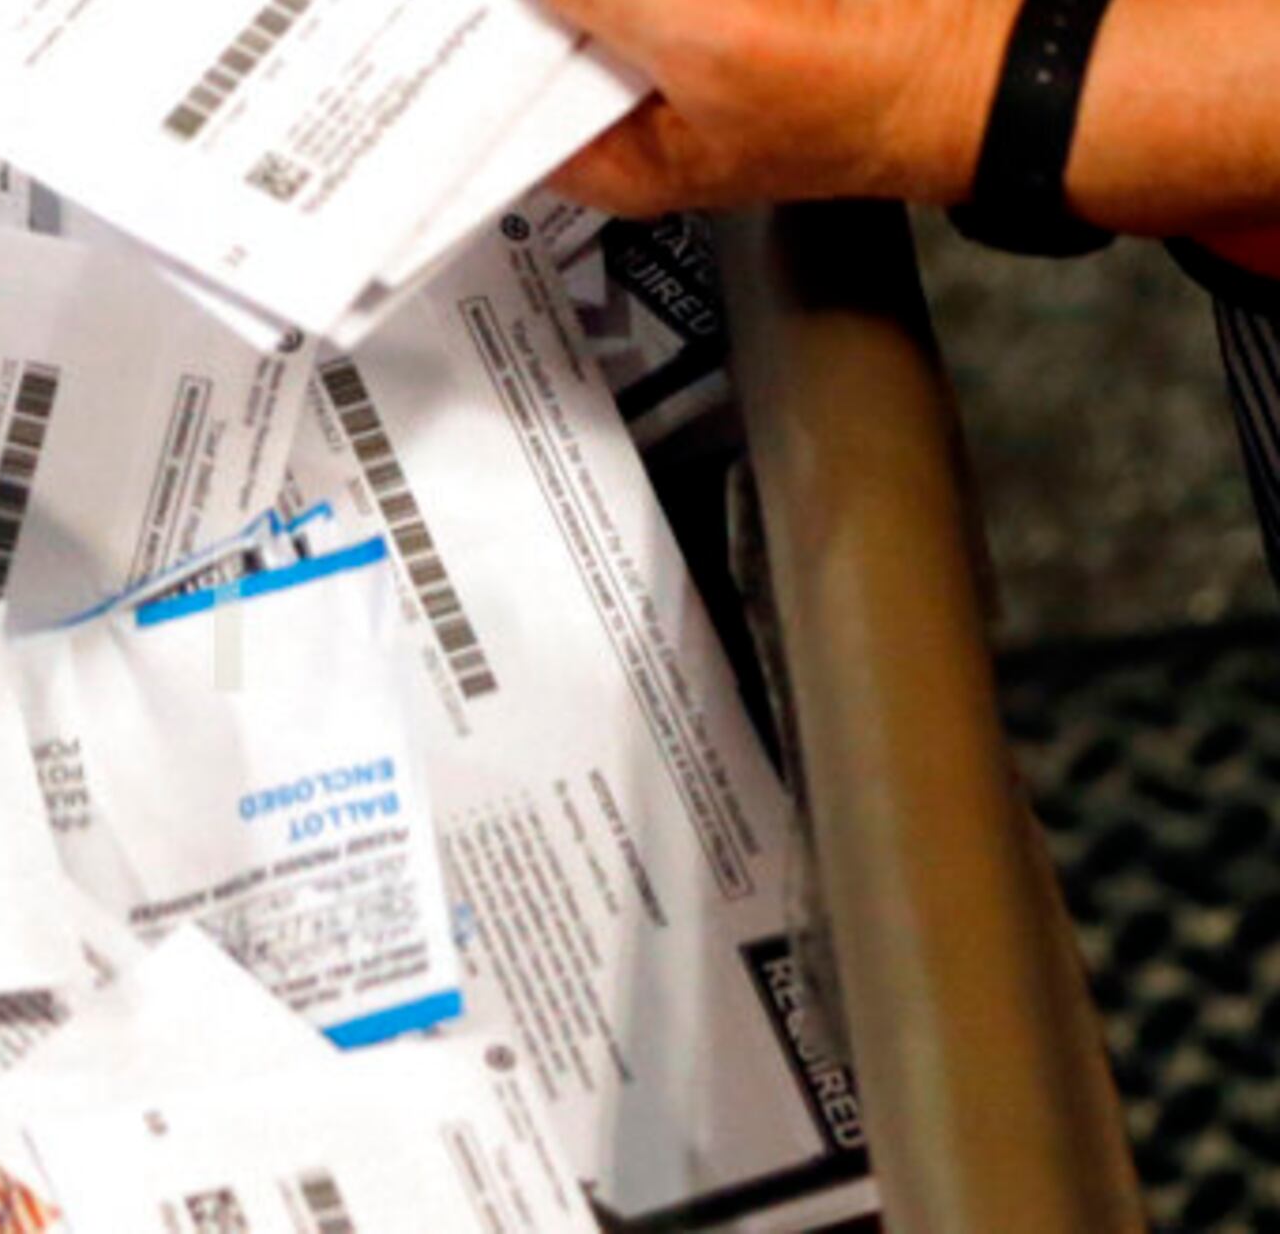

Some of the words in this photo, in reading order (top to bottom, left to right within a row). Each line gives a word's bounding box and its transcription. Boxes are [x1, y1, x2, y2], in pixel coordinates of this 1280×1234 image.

[506, 318, 537, 358] Your
[524, 355, 558, 402] ballot
[201, 418, 228, 461] Your
[546, 401, 575, 442] must
[564, 440, 587, 465] be
[187, 462, 217, 512] ballot
[499, 373, 536, 432] SIGNING
[526, 432, 568, 500] ANOTHER
[589, 570, 618, 612] NAME
[607, 612, 627, 633] TO
[573, 464, 616, 532] received
[602, 531, 625, 557] by
[235, 756, 396, 820] ENCLOSED
[284, 791, 400, 842] BALLOT
